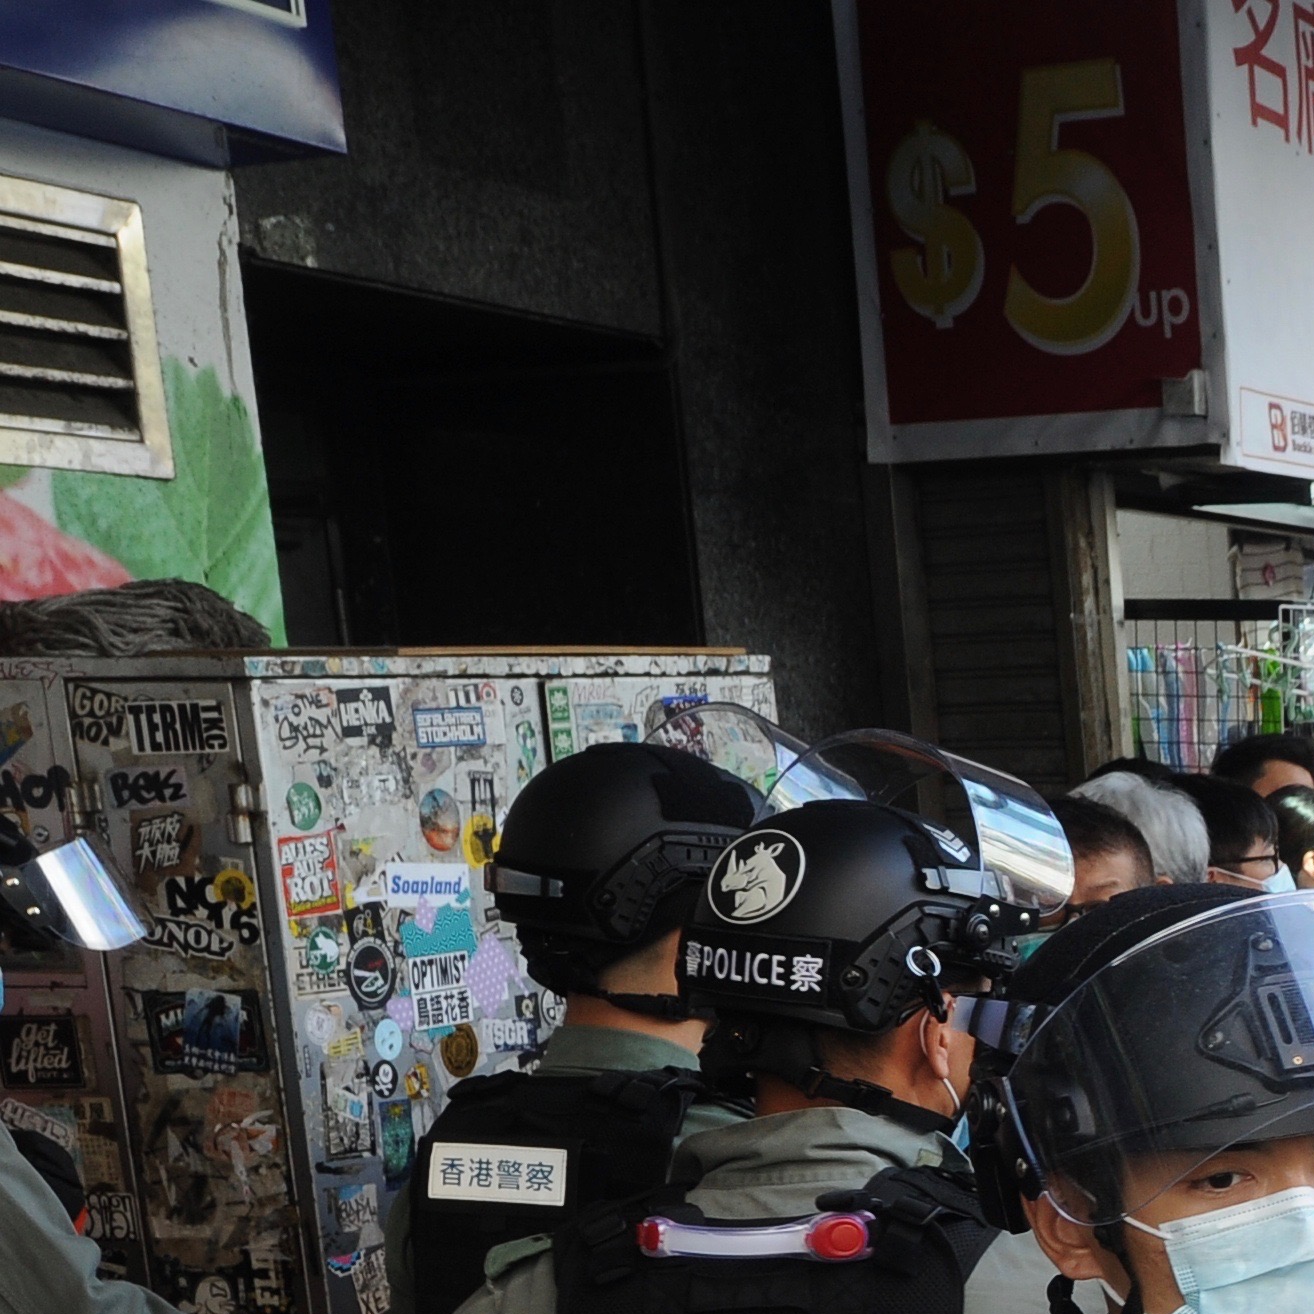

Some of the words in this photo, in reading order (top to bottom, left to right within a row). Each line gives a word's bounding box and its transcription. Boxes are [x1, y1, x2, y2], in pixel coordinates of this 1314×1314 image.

[1134, 286, 1190, 338] up
[341, 701, 393, 727] HENKA
[418, 724, 483, 744] STOCKHOLM
[391, 874, 463, 897] Soapland
[411, 953, 467, 991] OPTIMIST
[703, 946, 786, 986] POLICE
[790, 953, 824, 993] 察
[20, 1022, 58, 1047] get
[10, 1043, 71, 1083] lifted
[439, 1156, 555, 1193] 香港警察
